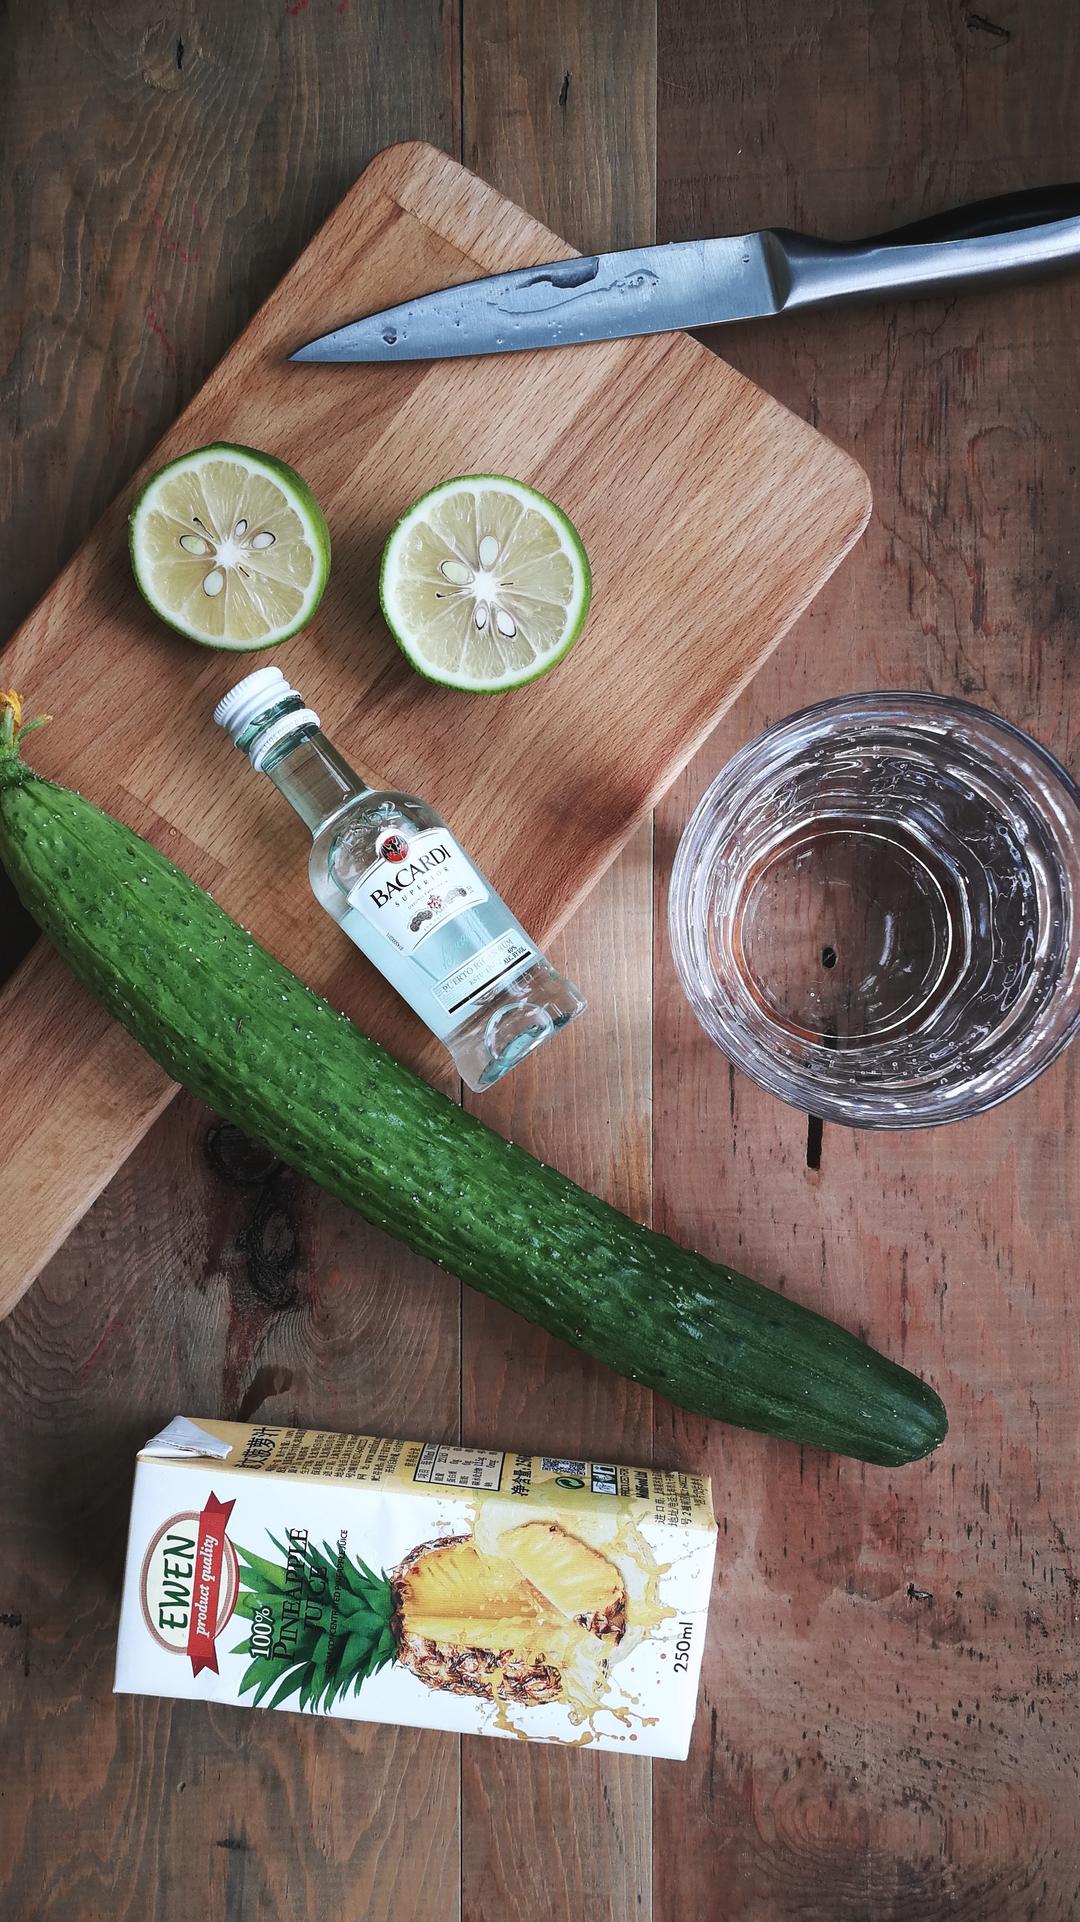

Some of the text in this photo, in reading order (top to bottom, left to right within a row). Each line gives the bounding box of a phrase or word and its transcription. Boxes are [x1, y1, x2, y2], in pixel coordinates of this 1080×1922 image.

[369, 845, 452, 908] BACARDI
[395, 867, 450, 907] SUPERIOR
[158, 1534, 196, 1630] EWEN
[196, 1533, 218, 1637] product quality
[272, 1528, 309, 1661] PINEAPPLE
[251, 1607, 273, 1658] 100%
[673, 1622, 693, 1672] 250ml
